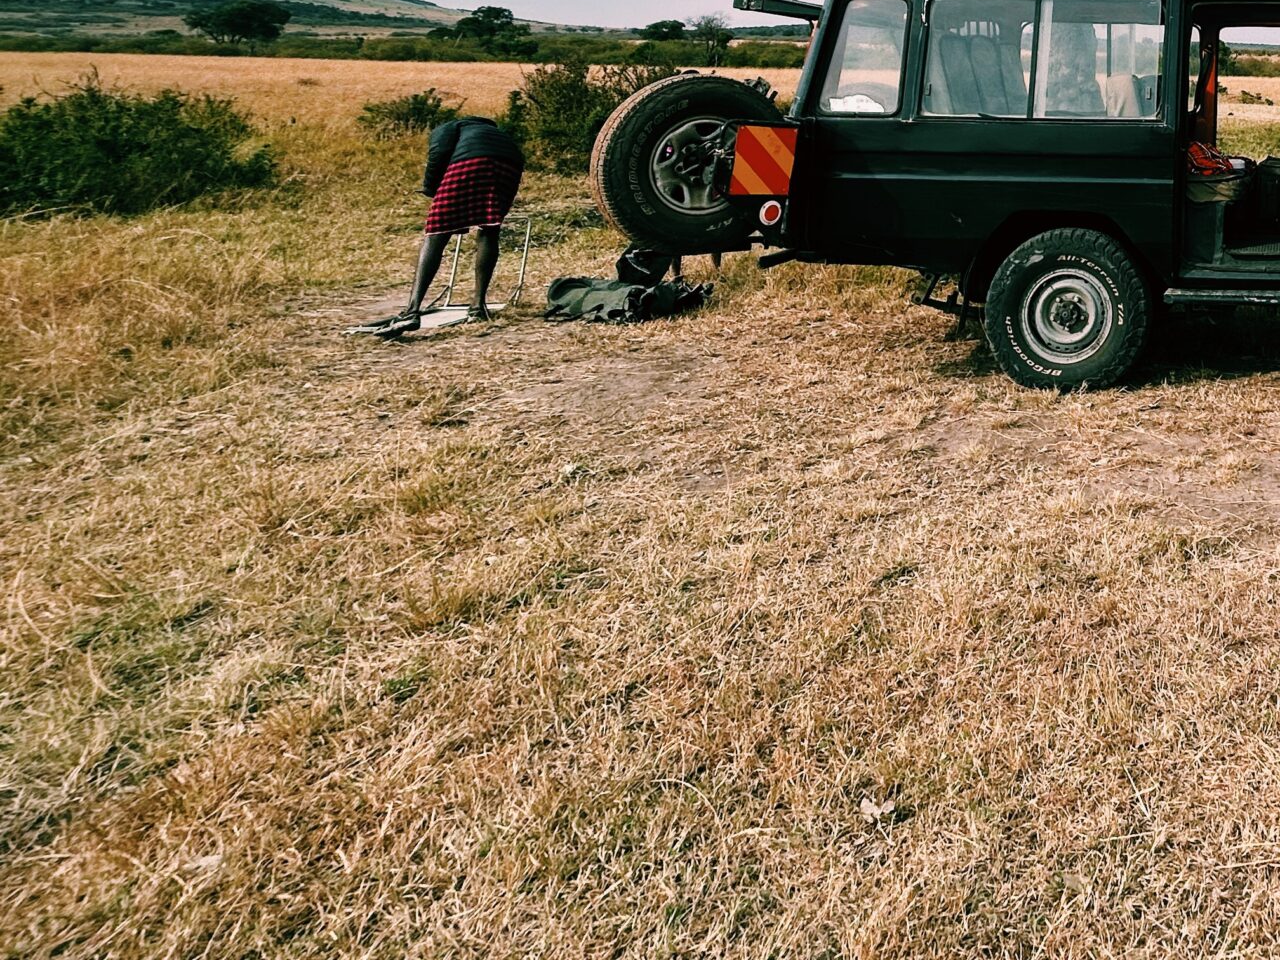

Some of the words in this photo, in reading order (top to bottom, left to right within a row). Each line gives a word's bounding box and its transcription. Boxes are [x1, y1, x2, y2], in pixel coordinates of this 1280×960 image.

[629, 99, 689, 216] BRIDGESTONE
[1056, 255, 1119, 297] All-Terrain
[1117, 304, 1125, 326] T/A
[1005, 317, 1063, 376] BFGoodrich
